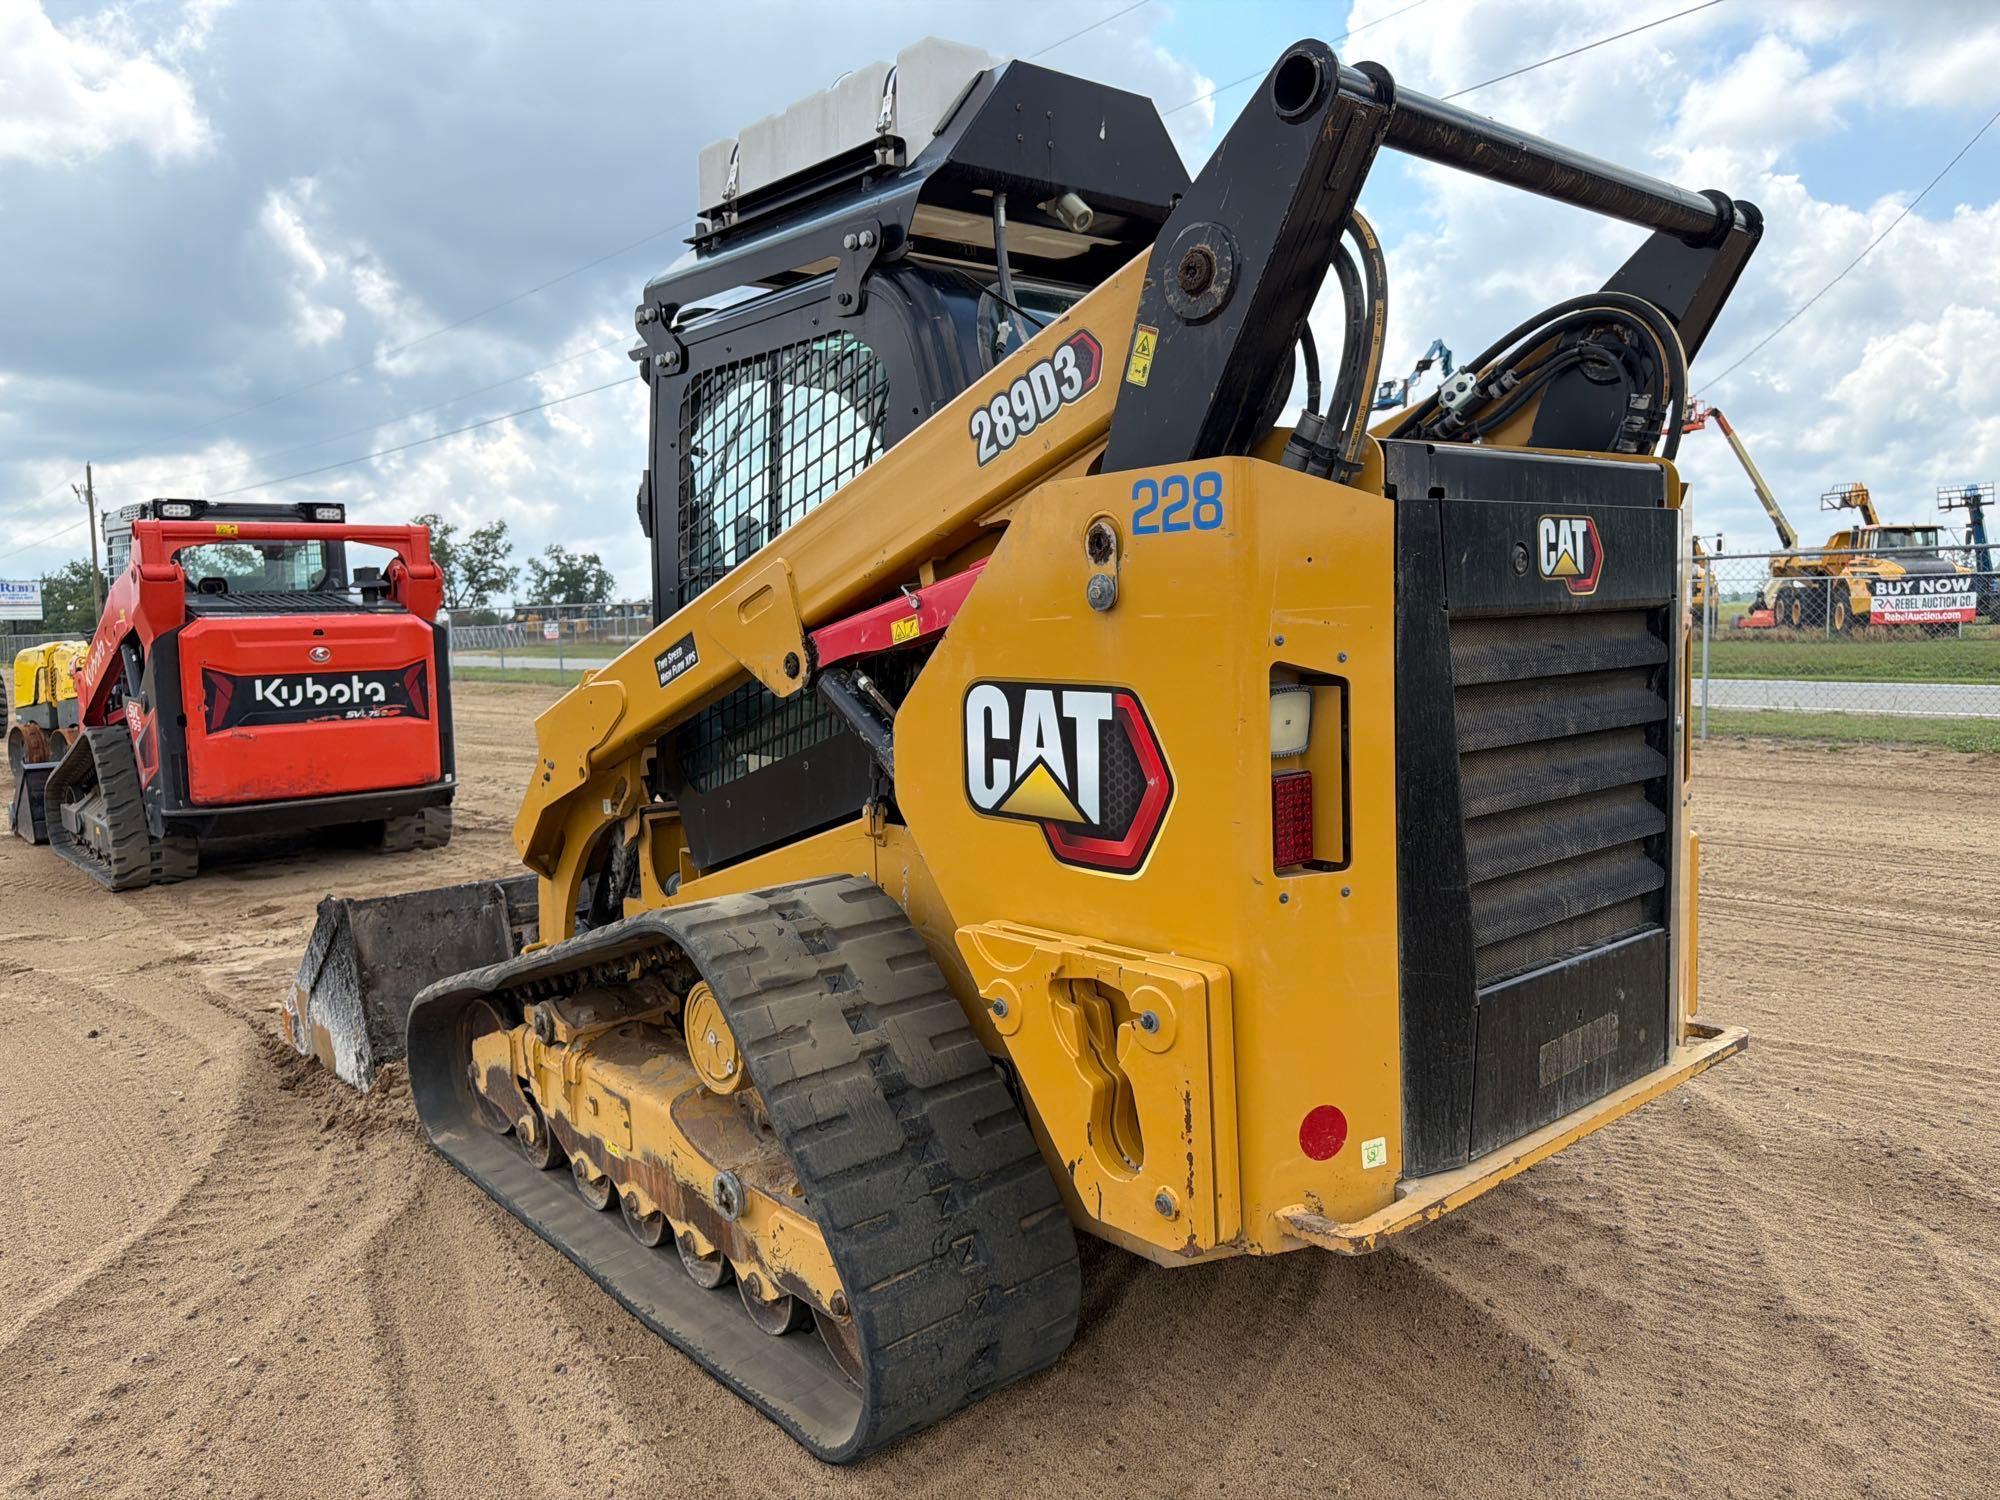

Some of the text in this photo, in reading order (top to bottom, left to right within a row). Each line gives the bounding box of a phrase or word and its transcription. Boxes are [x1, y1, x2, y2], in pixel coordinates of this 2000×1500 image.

[971, 345, 1083, 463] 289D3
[1132, 471, 1224, 535] 228
[1540, 518, 1587, 575] CAT
[1875, 578, 1971, 595] BUY NOW
[1895, 598, 1919, 610] REBEL
[1922, 596, 1957, 609] AUCTION
[1884, 611, 1961, 622] RebelAuction.com
[255, 675, 386, 708] Kubota
[966, 685, 1112, 825] CAT
